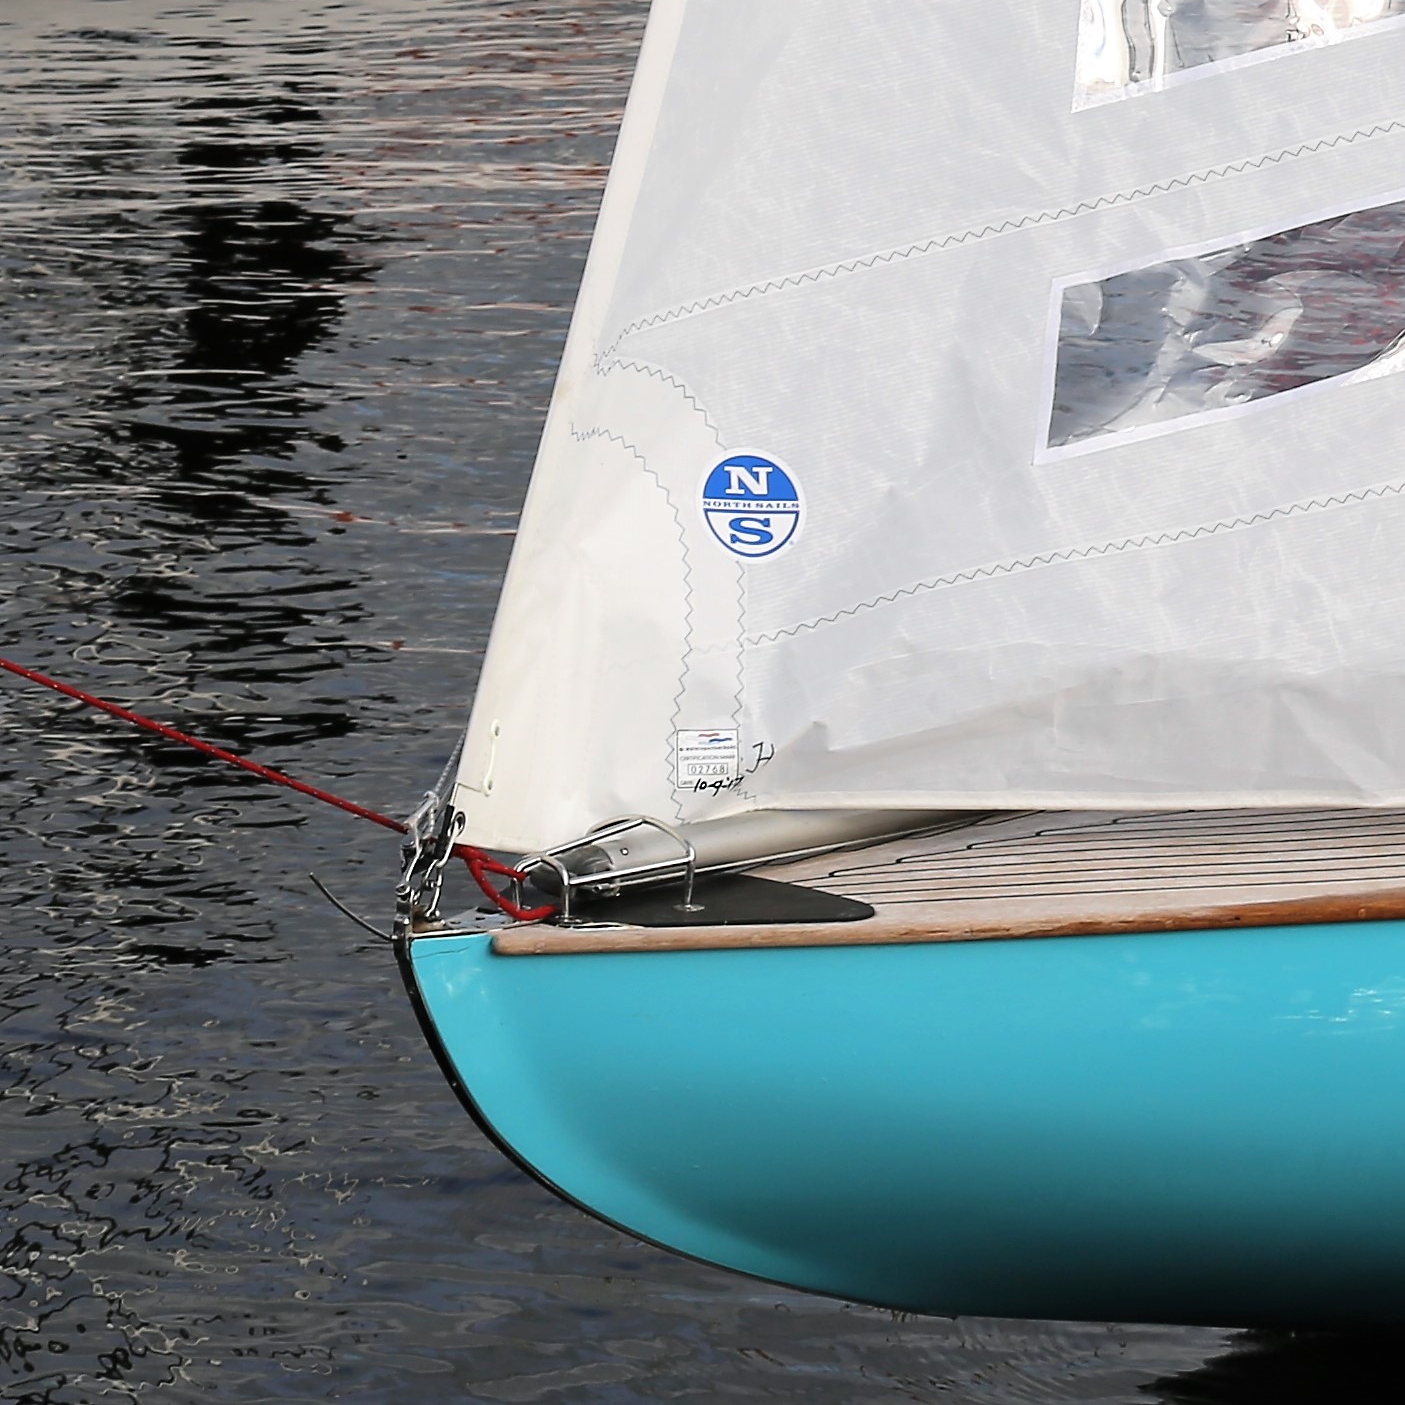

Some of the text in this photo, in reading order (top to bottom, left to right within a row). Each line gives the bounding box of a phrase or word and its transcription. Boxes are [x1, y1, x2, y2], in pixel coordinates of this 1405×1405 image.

[723, 465, 774, 495] N
[703, 500, 751, 509] NORTH
[728, 517, 774, 546] S
[691, 766, 726, 774] 02768
